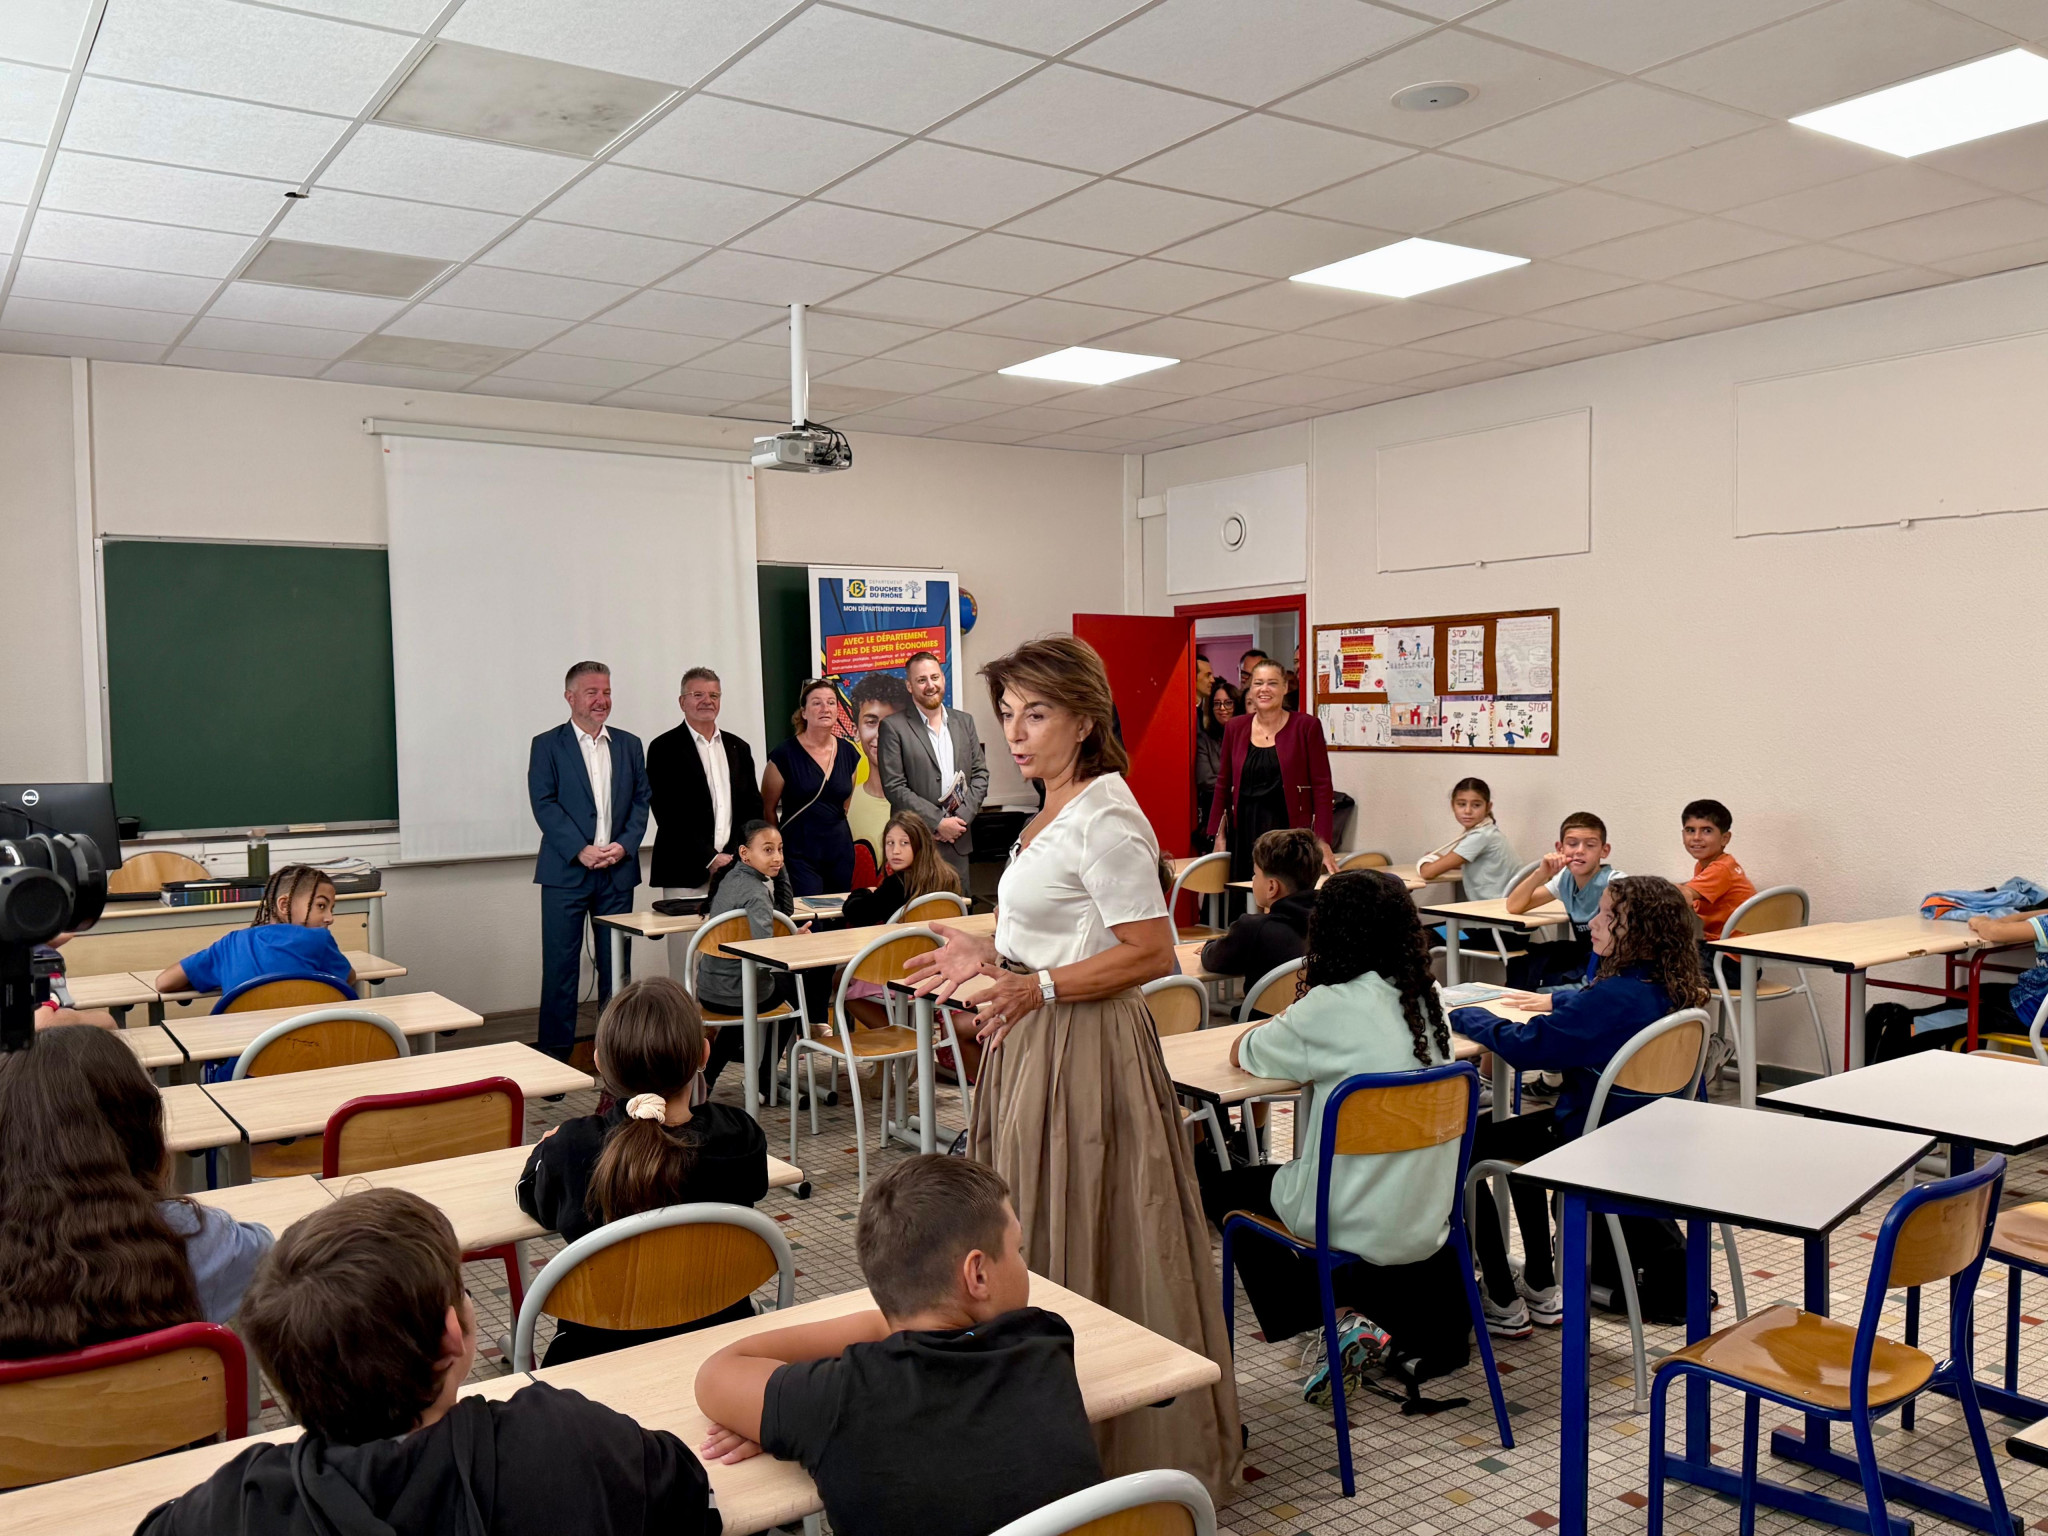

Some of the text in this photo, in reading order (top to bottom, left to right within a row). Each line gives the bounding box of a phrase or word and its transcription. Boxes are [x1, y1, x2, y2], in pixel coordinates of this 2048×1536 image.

[880, 591, 903, 599] RHÔNE
[858, 604, 895, 612] DÉPARTEMENT
[1452, 629, 1467, 638] STOP
[843, 631, 928, 646] AVEC LE DÉPARTEMENT,
[833, 639, 939, 657] JE FAIS DE SUPER ÉCONOMIES
